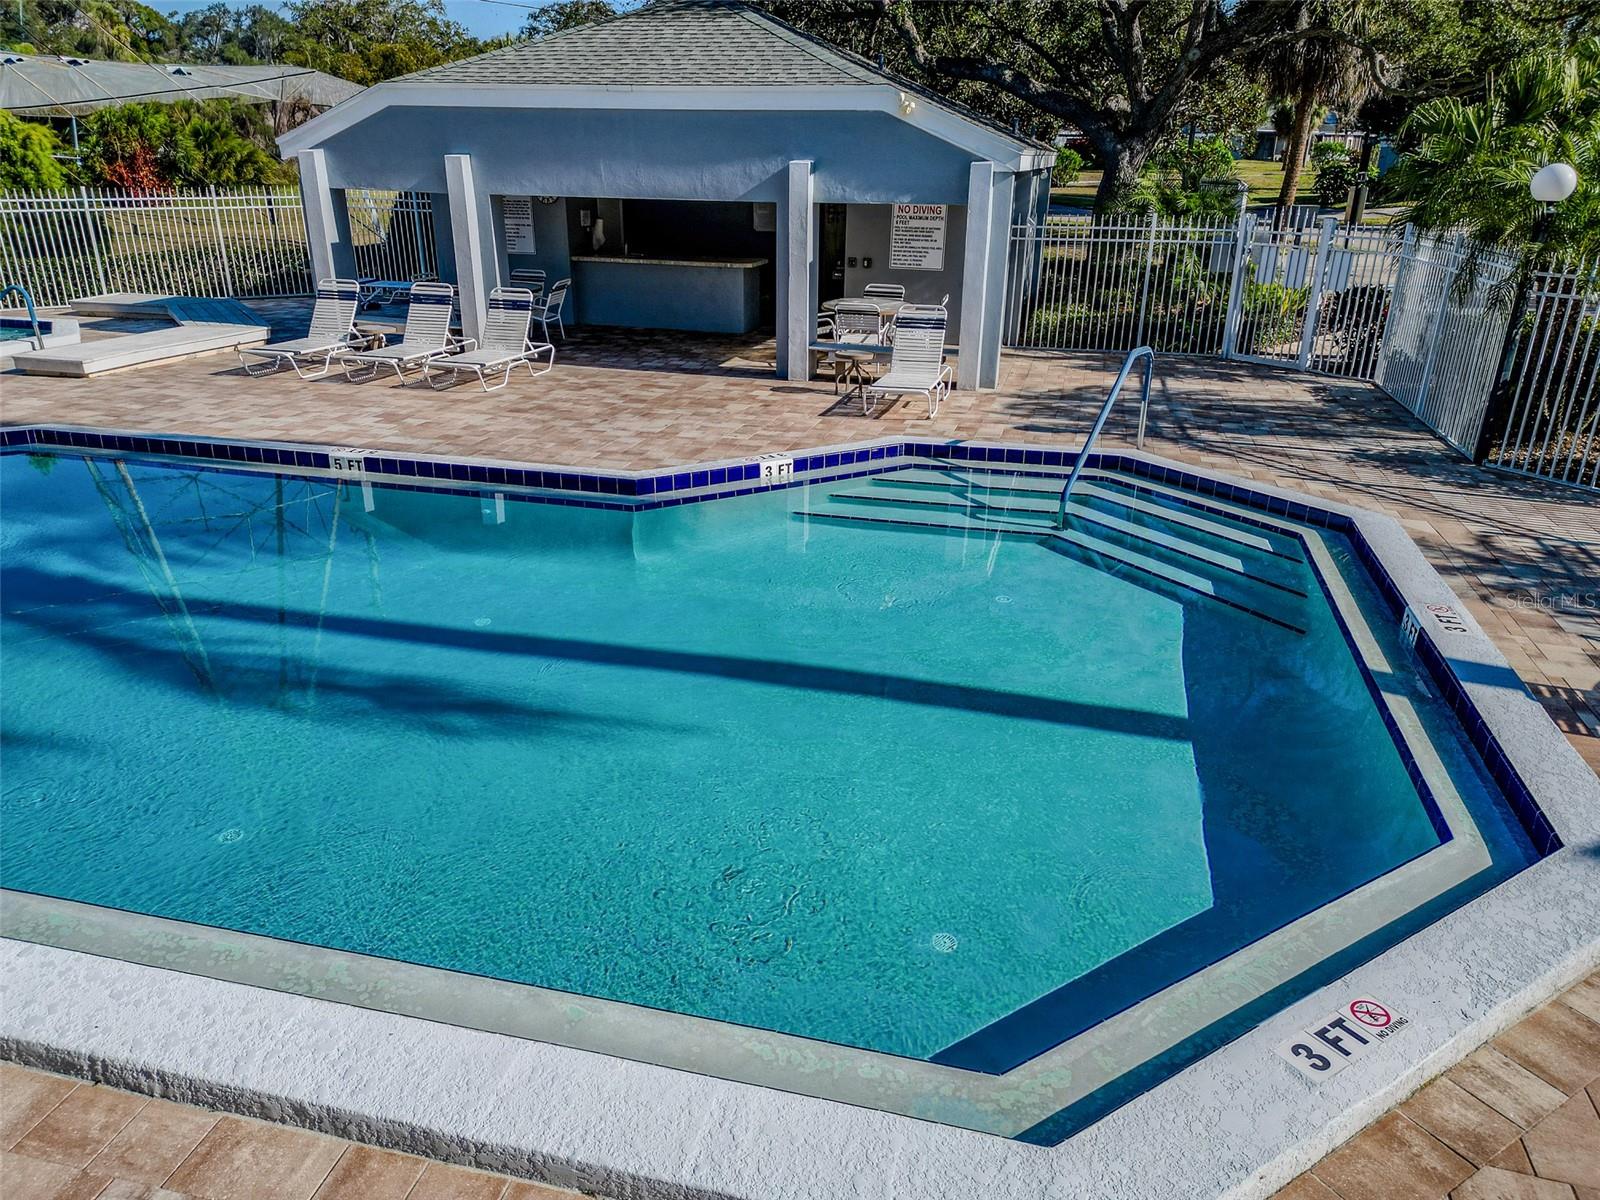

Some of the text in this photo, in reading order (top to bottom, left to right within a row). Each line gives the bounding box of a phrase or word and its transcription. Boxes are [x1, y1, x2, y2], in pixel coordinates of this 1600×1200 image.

[898, 204, 942, 215] NO DIVING
[334, 458, 363, 471] 5 FT
[765, 462, 793, 478] 3 FT
[1434, 613, 1463, 625] FT
[1375, 1016, 1409, 1040] NO DIVING
[1290, 1017, 1370, 1072] 3 FT
